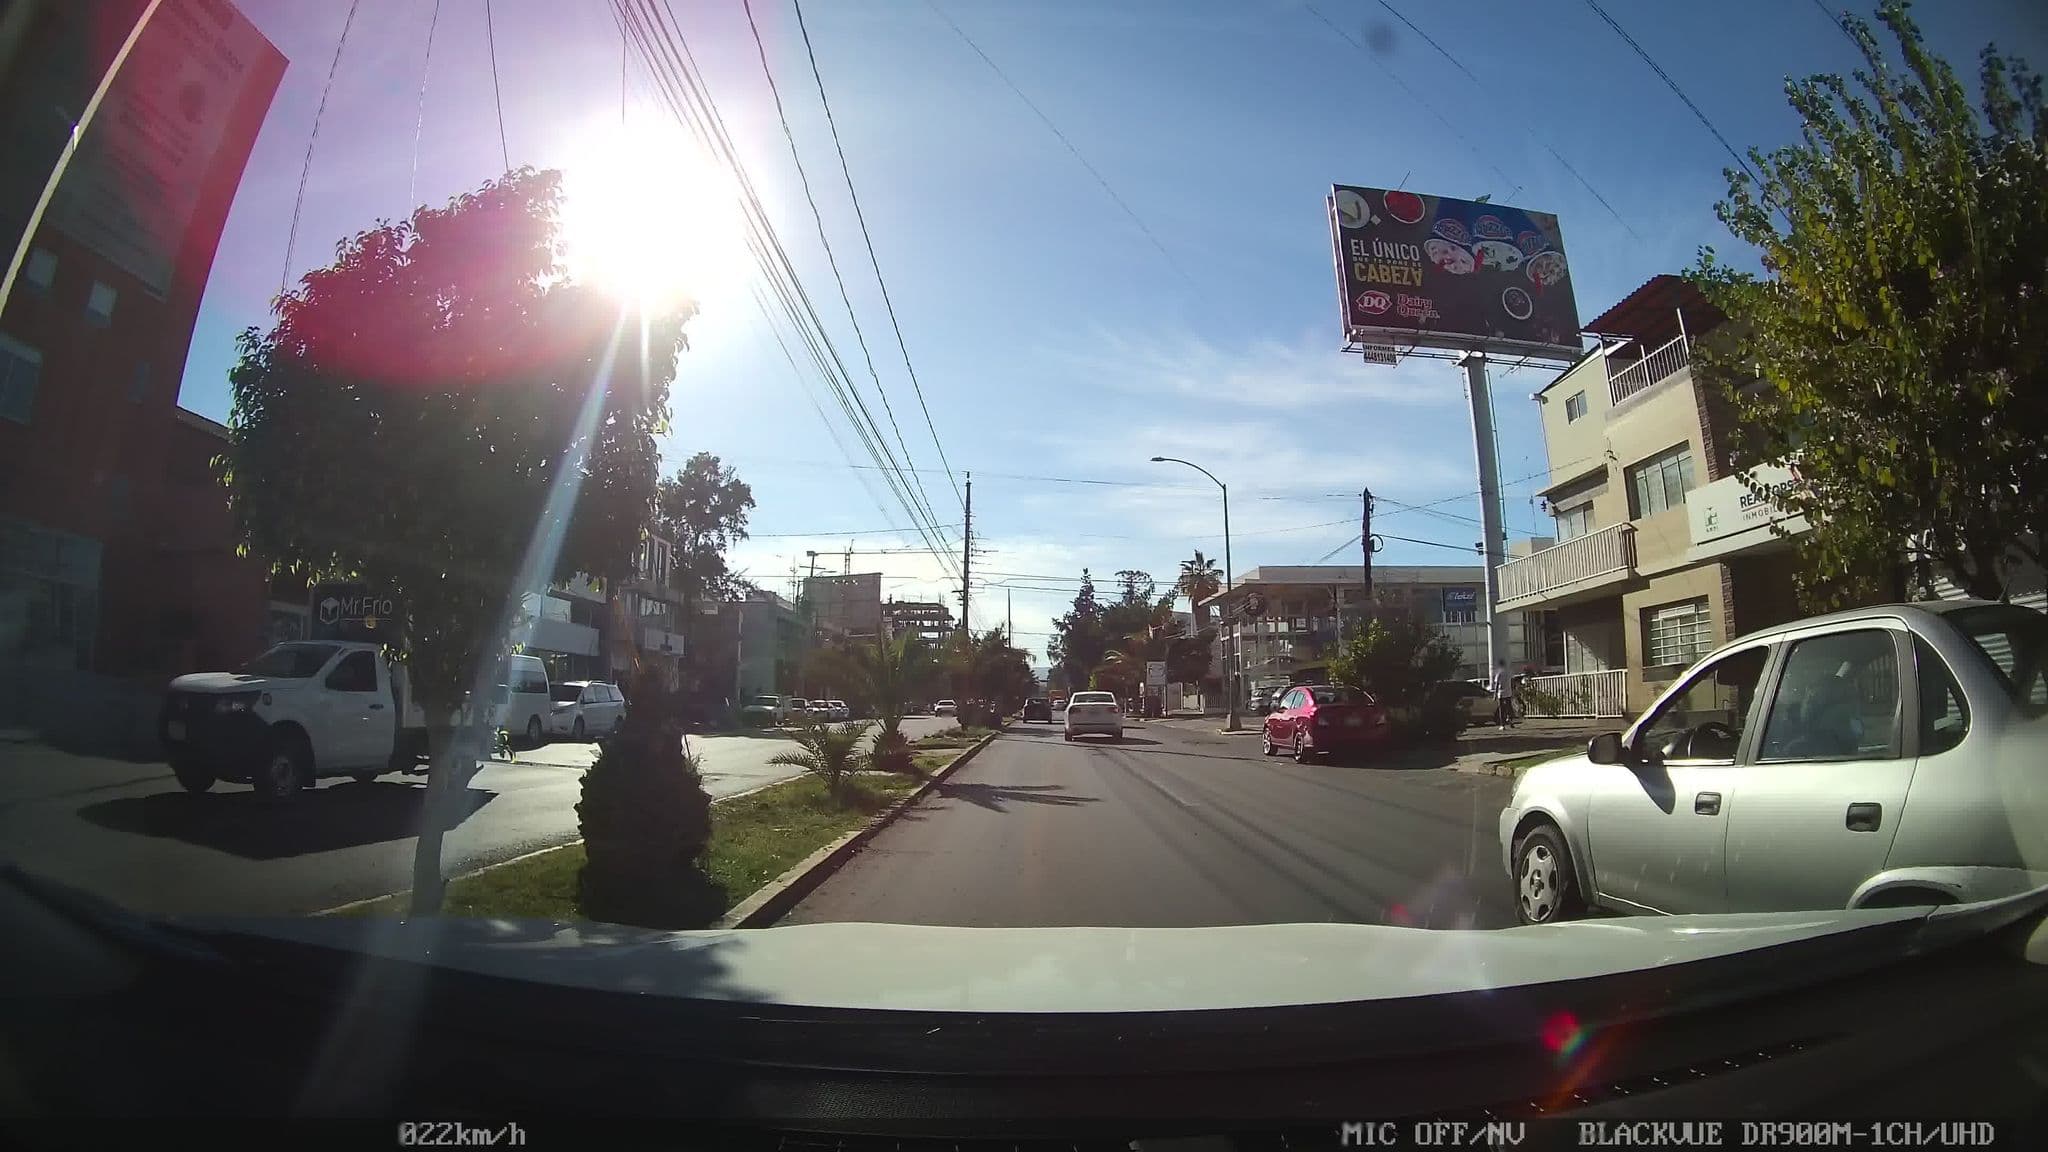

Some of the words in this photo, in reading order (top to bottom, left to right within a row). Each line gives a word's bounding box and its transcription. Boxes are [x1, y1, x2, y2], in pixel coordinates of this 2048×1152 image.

[1351, 239, 1369, 256] EL
[1373, 237, 1419, 261] ÚNICO
[1363, 295, 1386, 310] DQ
[1398, 293, 1432, 309] Dairy
[1398, 305, 1440, 323] Queen
